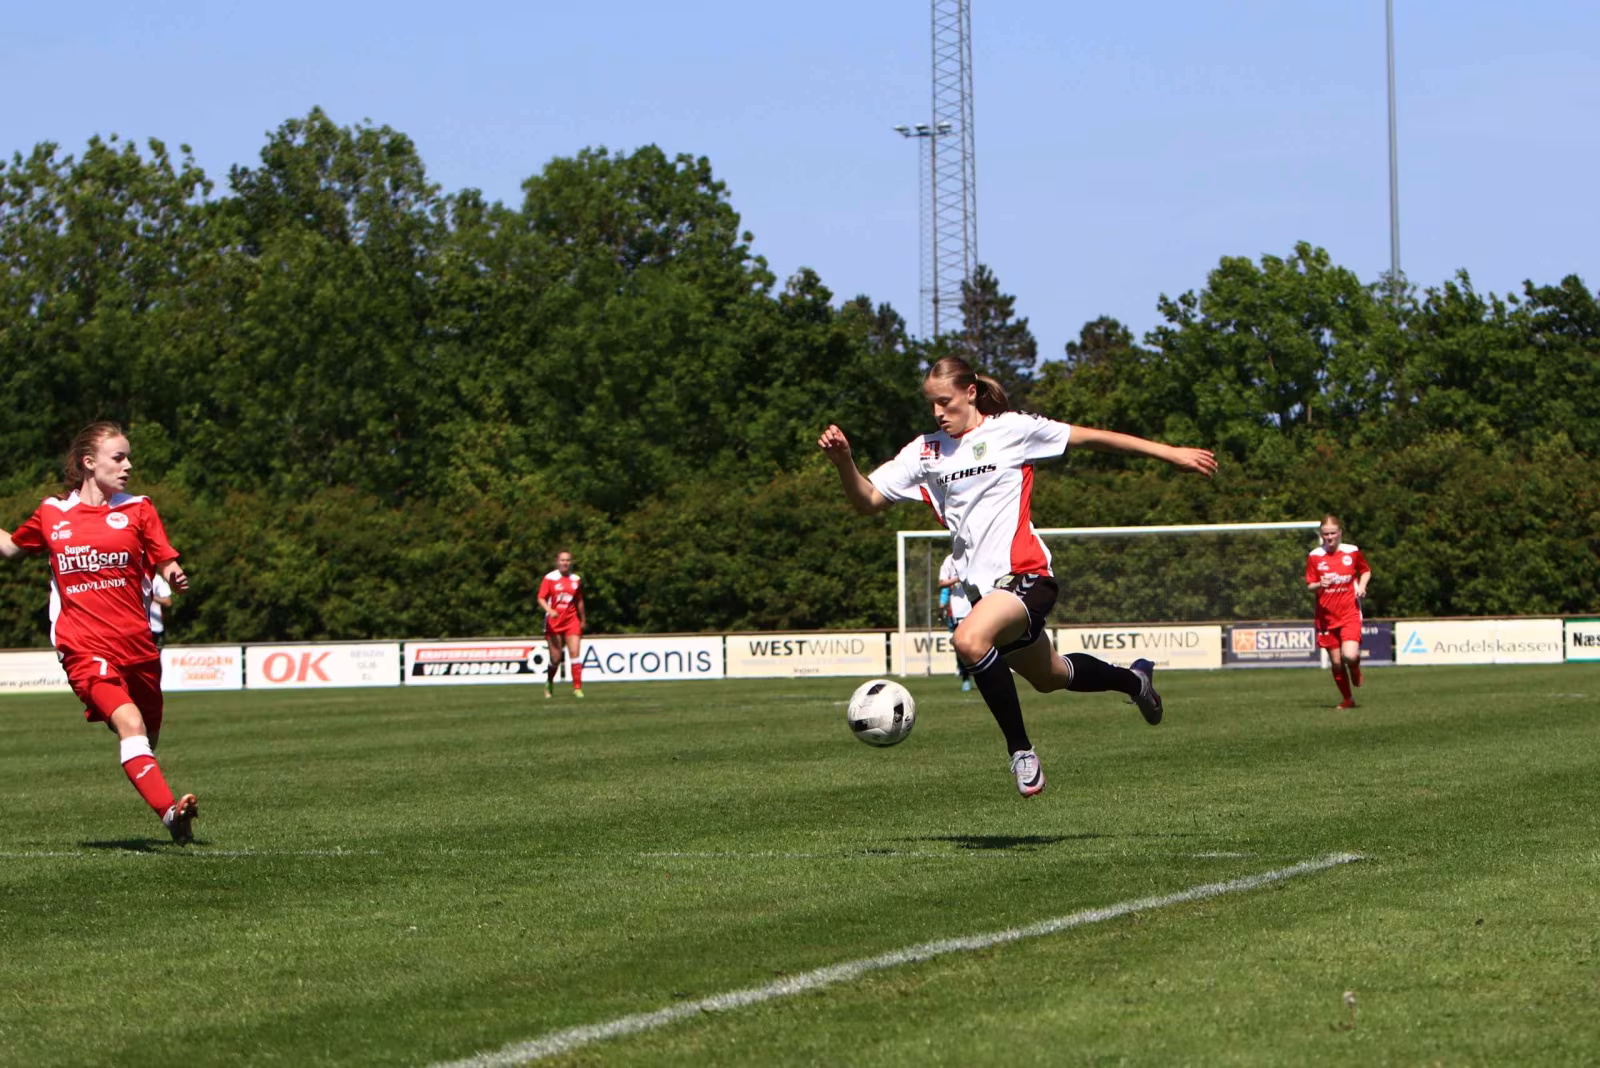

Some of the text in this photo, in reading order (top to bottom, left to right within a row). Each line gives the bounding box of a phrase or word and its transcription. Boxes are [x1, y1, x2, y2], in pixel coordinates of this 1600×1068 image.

[64, 545, 91, 555] Super
[56, 550, 129, 572] Brugsen
[66, 577, 127, 595] SKOVLUNDE
[749, 638, 865, 657] WESTWIND
[1080, 631, 1199, 650] WESTWIND
[1257, 631, 1311, 649] STARK
[1434, 639, 1559, 653] Andelskassen
[93, 657, 108, 676] 7
[262, 651, 334, 683] OK
[423, 662, 521, 676] VIF FODBOLD
[582, 645, 711, 674] Acronis
